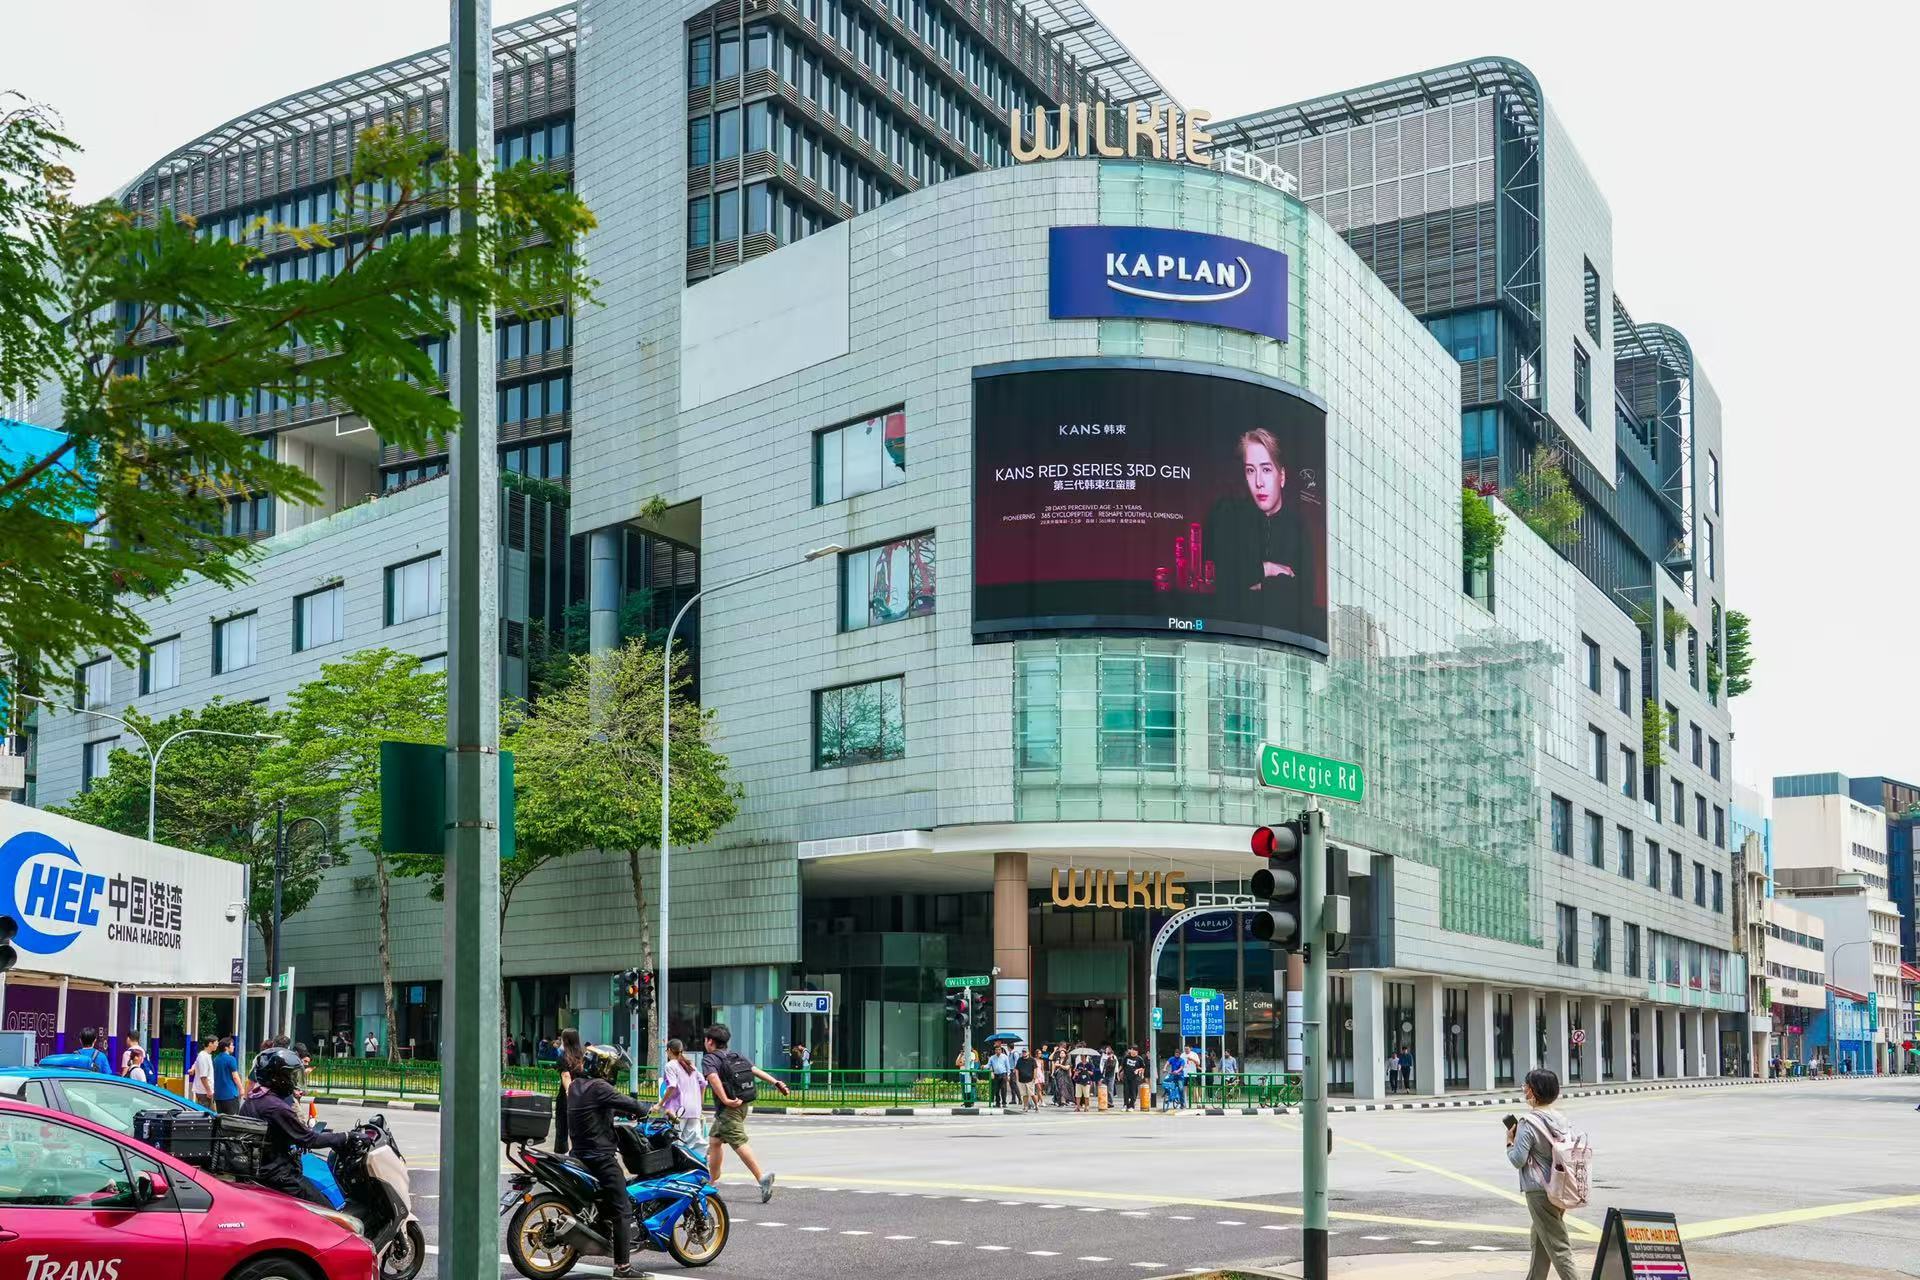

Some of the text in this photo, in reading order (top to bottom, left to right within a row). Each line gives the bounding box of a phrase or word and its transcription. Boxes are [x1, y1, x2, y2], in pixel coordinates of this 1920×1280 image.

[1011, 101, 1212, 166] WILKIE
[1225, 146, 1298, 194] EDGE
[1106, 252, 1236, 288] KAPLAN
[1059, 424, 1101, 436] KANS
[995, 463, 1191, 482] KANS RED SERIES 3RD GEN
[1002, 513, 1036, 522] PIONEERING
[1051, 511, 1093, 519] CYCLOPEPTIDE
[1153, 511, 1184, 520] DIMENSION
[1271, 751, 1356, 792] Selegie Rd
[1051, 867, 1186, 910] WILKIE
[108, 872, 183, 932] 中国港湾
[1194, 920, 1228, 928] KAPLAN
[107, 923, 182, 950] CHINA HARBOUR
[976, 977, 986, 985] Rd
[1184, 1003, 1199, 1012] Bus
[7, 1011, 55, 1038] OFFICE
[1650, 1228, 1664, 1242] HAIR
[25, 1253, 122, 1280] TRANS
